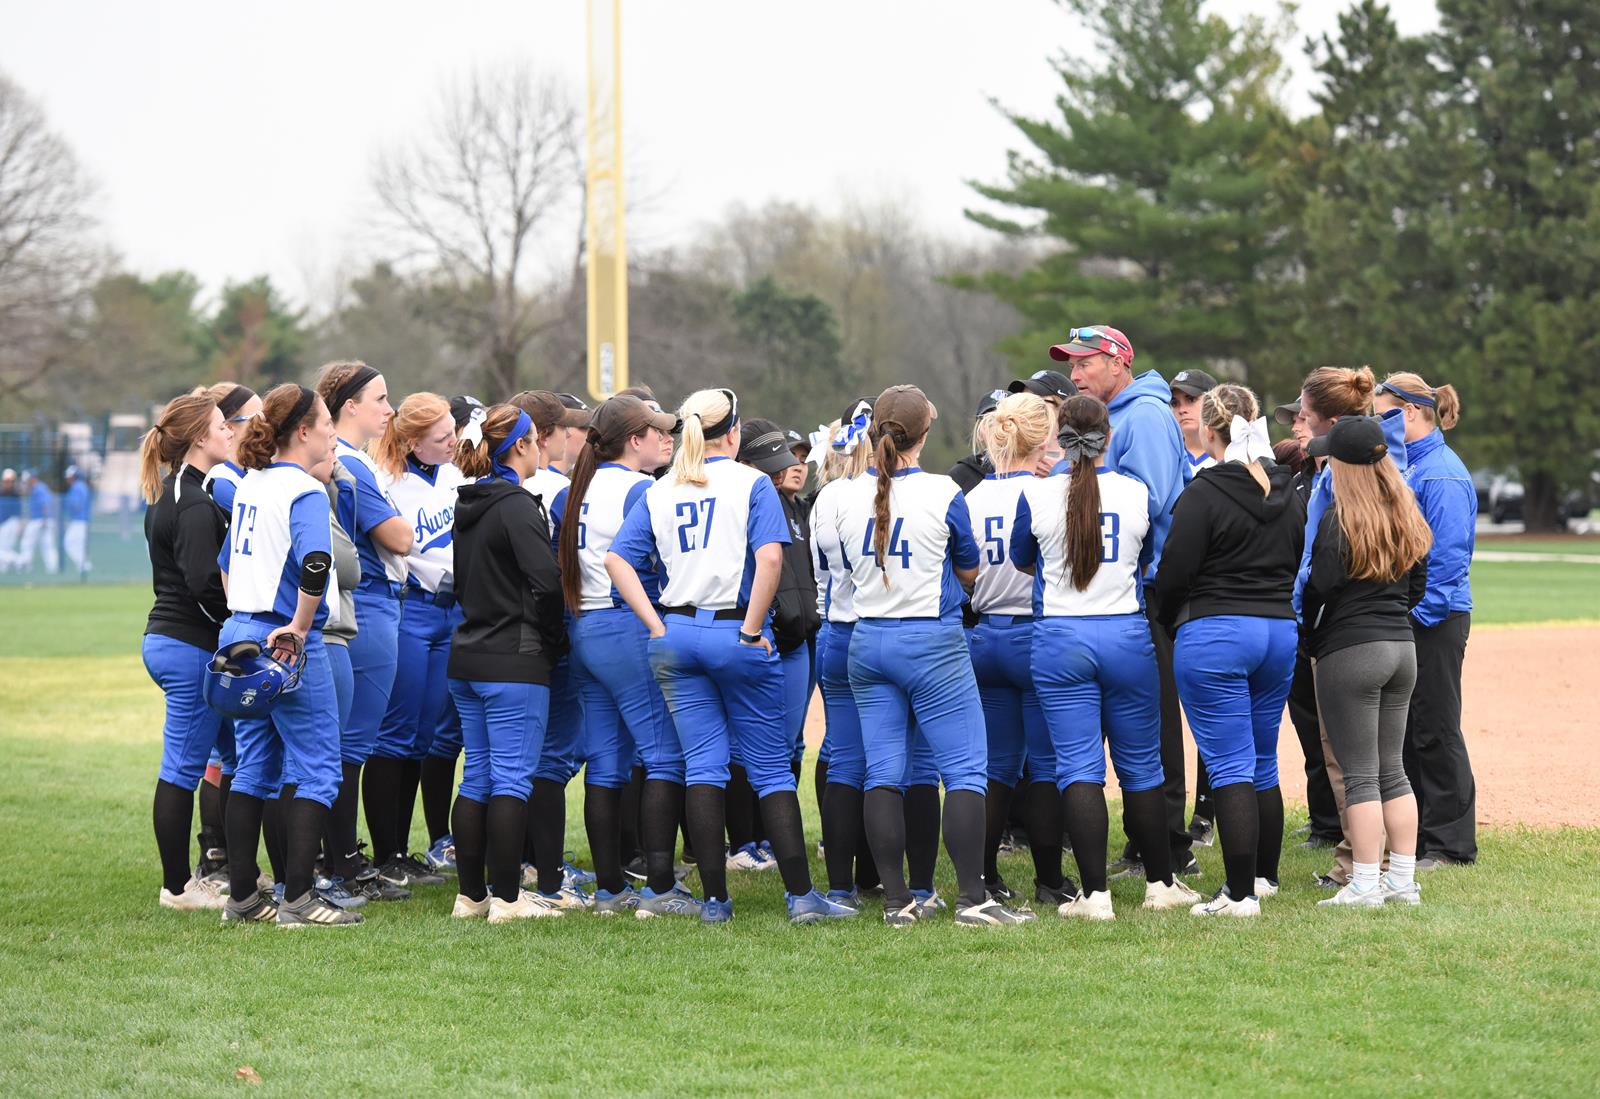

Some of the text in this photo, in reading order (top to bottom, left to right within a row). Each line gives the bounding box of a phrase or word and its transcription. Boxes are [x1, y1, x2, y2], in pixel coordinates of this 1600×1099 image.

[235, 503, 257, 556] 13
[676, 497, 716, 553] 27
[862, 517, 912, 569] 44
[985, 516, 1005, 566] 5
